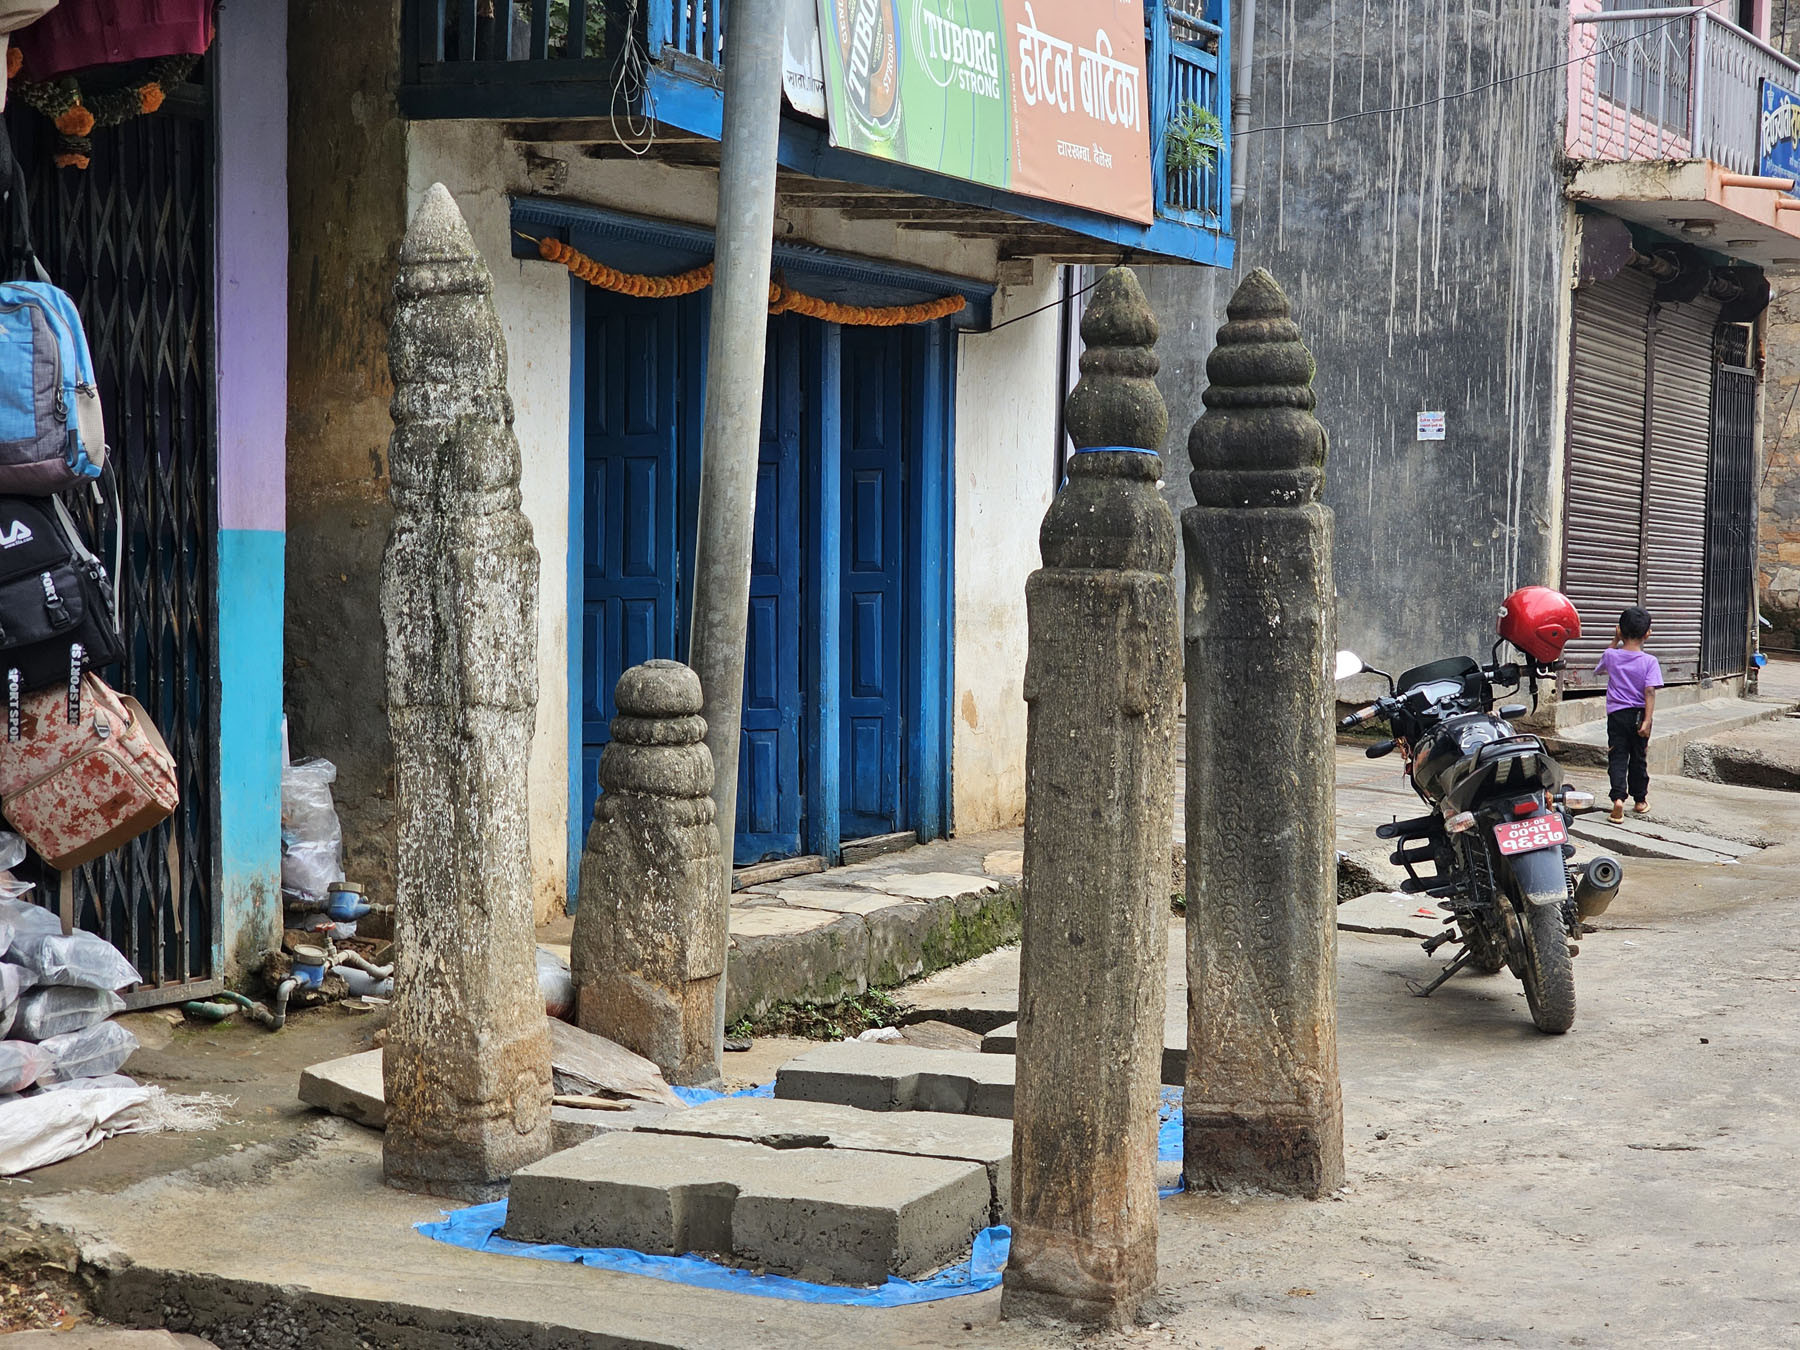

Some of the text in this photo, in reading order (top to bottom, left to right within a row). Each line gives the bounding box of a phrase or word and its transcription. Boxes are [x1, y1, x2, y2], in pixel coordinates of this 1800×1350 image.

[848, 0, 878, 105] TUBO
[922, 7, 999, 79] TUBORG
[1016, 1, 1075, 114] होटल
[958, 67, 1001, 100] STRONG
[1502, 831, 1564, 850] १६६७
